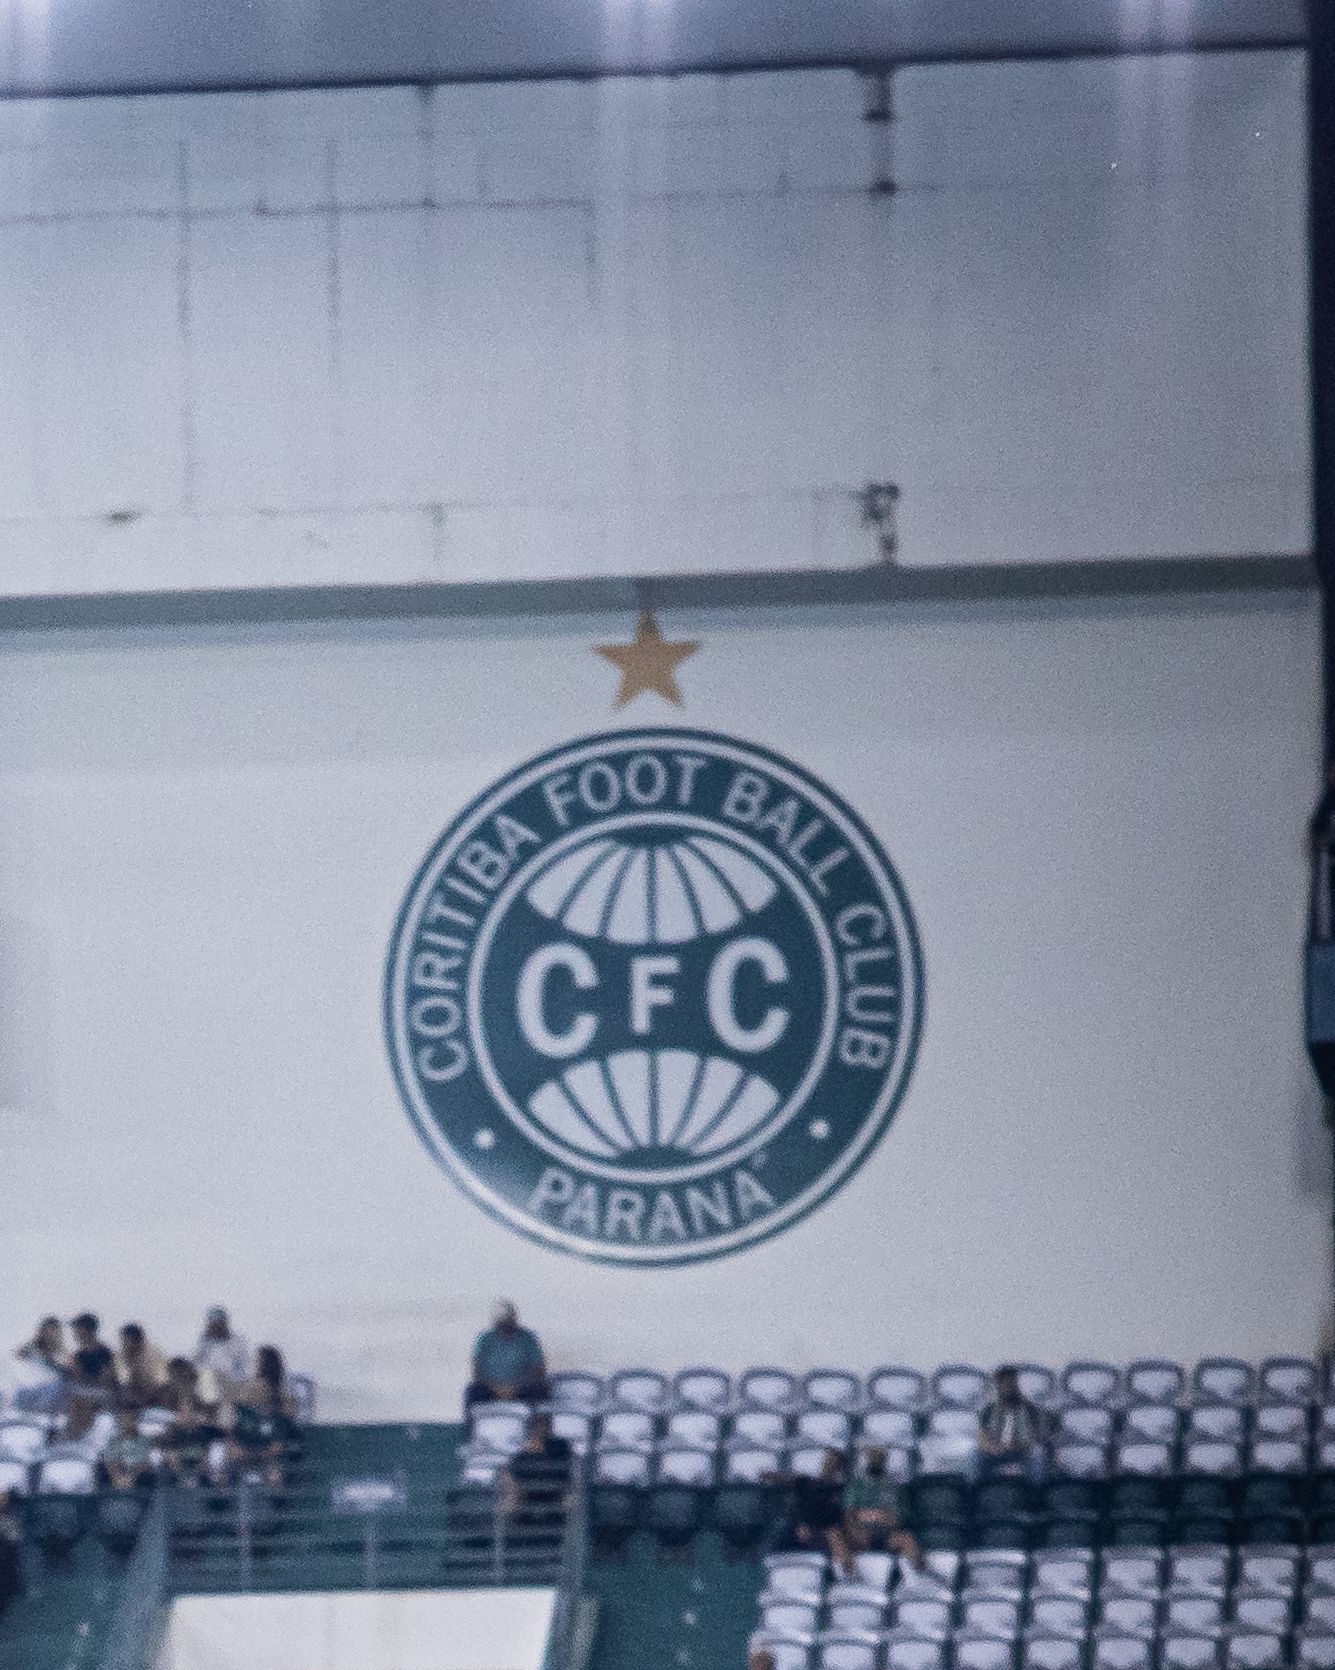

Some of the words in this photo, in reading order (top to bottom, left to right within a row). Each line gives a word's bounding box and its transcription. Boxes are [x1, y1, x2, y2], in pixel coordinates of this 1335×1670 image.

[410, 815, 542, 1083] CORITIBA
[543, 753, 710, 827] FOOT
[720, 768, 854, 898] BALL
[834, 902, 893, 1071] CLUB
